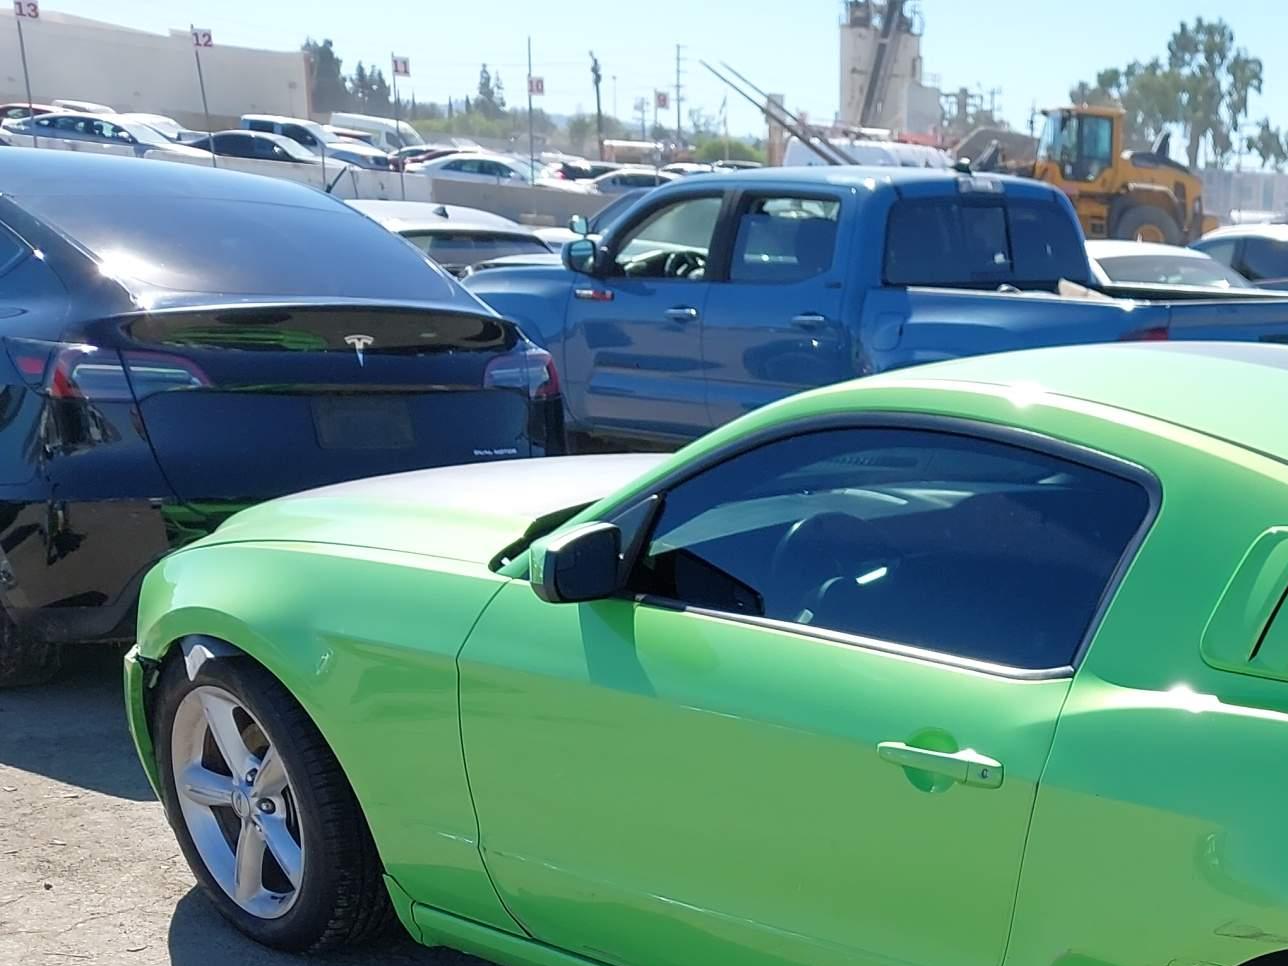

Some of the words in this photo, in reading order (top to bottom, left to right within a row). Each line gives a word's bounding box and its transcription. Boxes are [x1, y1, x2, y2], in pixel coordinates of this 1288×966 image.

[15, 1, 39, 18] 13
[192, 31, 213, 47] 12
[393, 59, 410, 73] 11
[528, 78, 544, 93] 10
